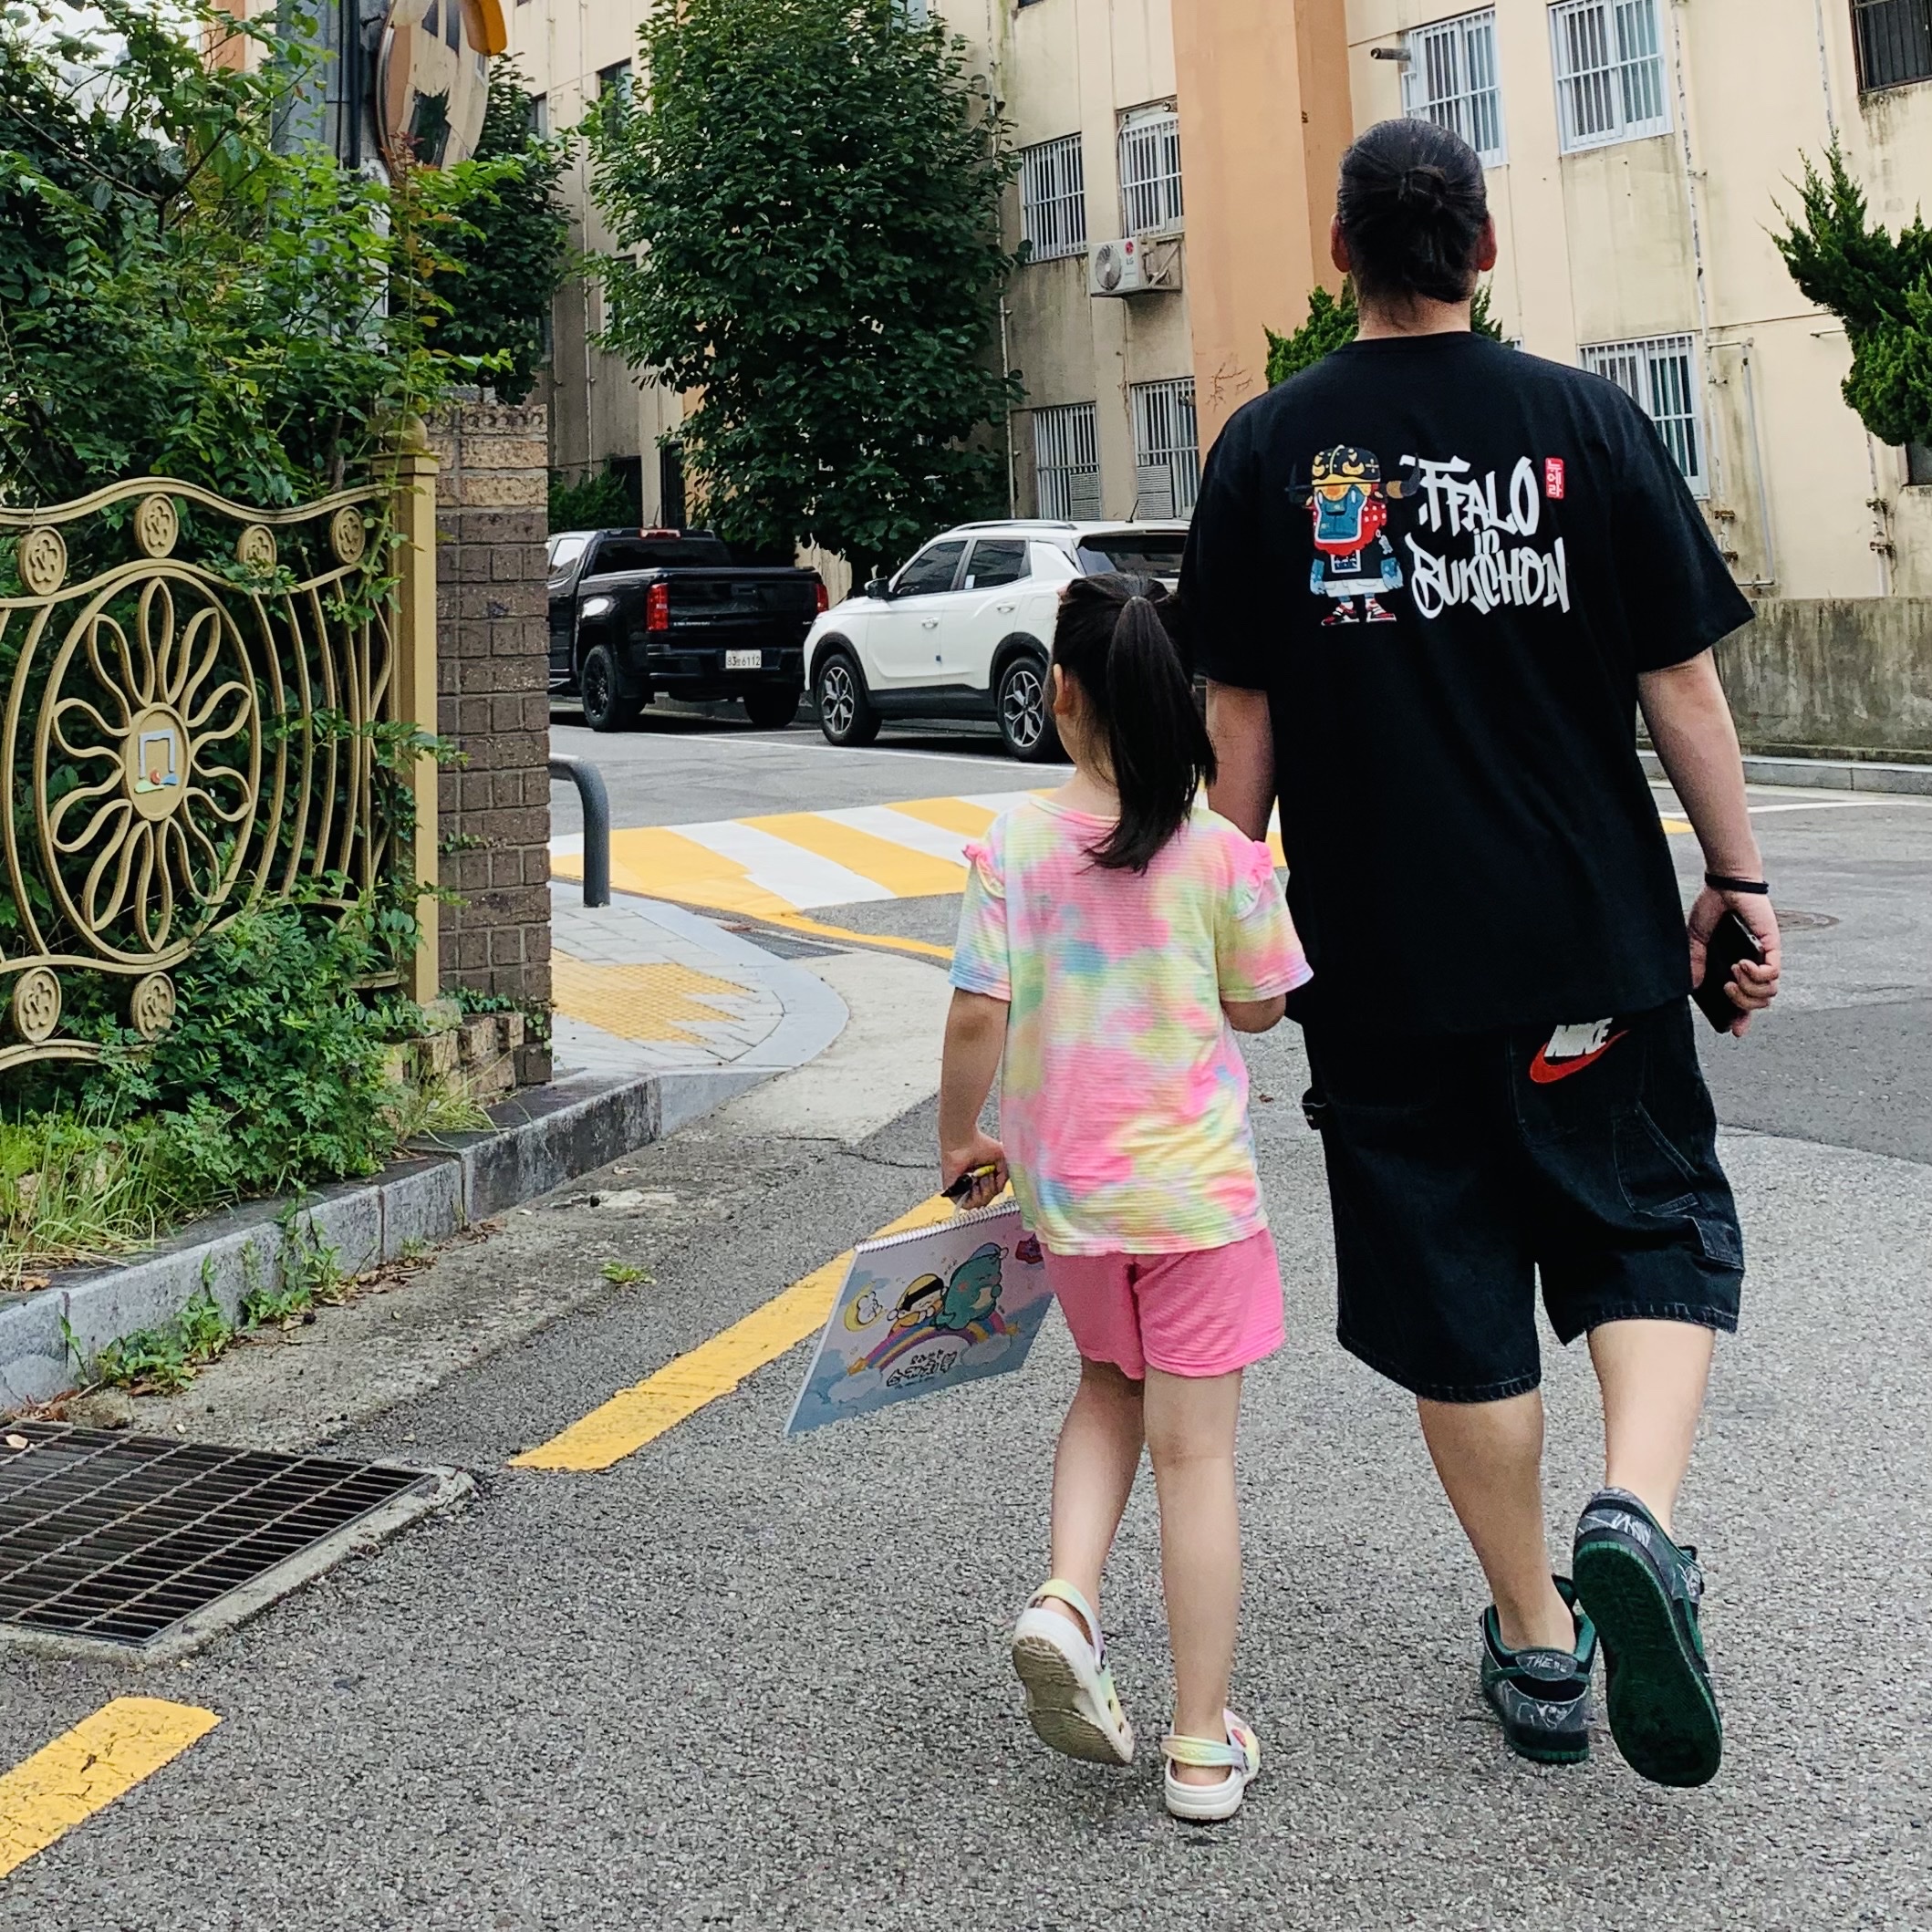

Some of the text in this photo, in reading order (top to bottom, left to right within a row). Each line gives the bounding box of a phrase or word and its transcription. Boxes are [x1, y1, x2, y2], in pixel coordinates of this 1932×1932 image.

[1546, 458, 1563, 498] 뉴에라
[1404, 533, 1570, 619] BUKCHON
[1543, 1017, 1614, 1057] NIKE
